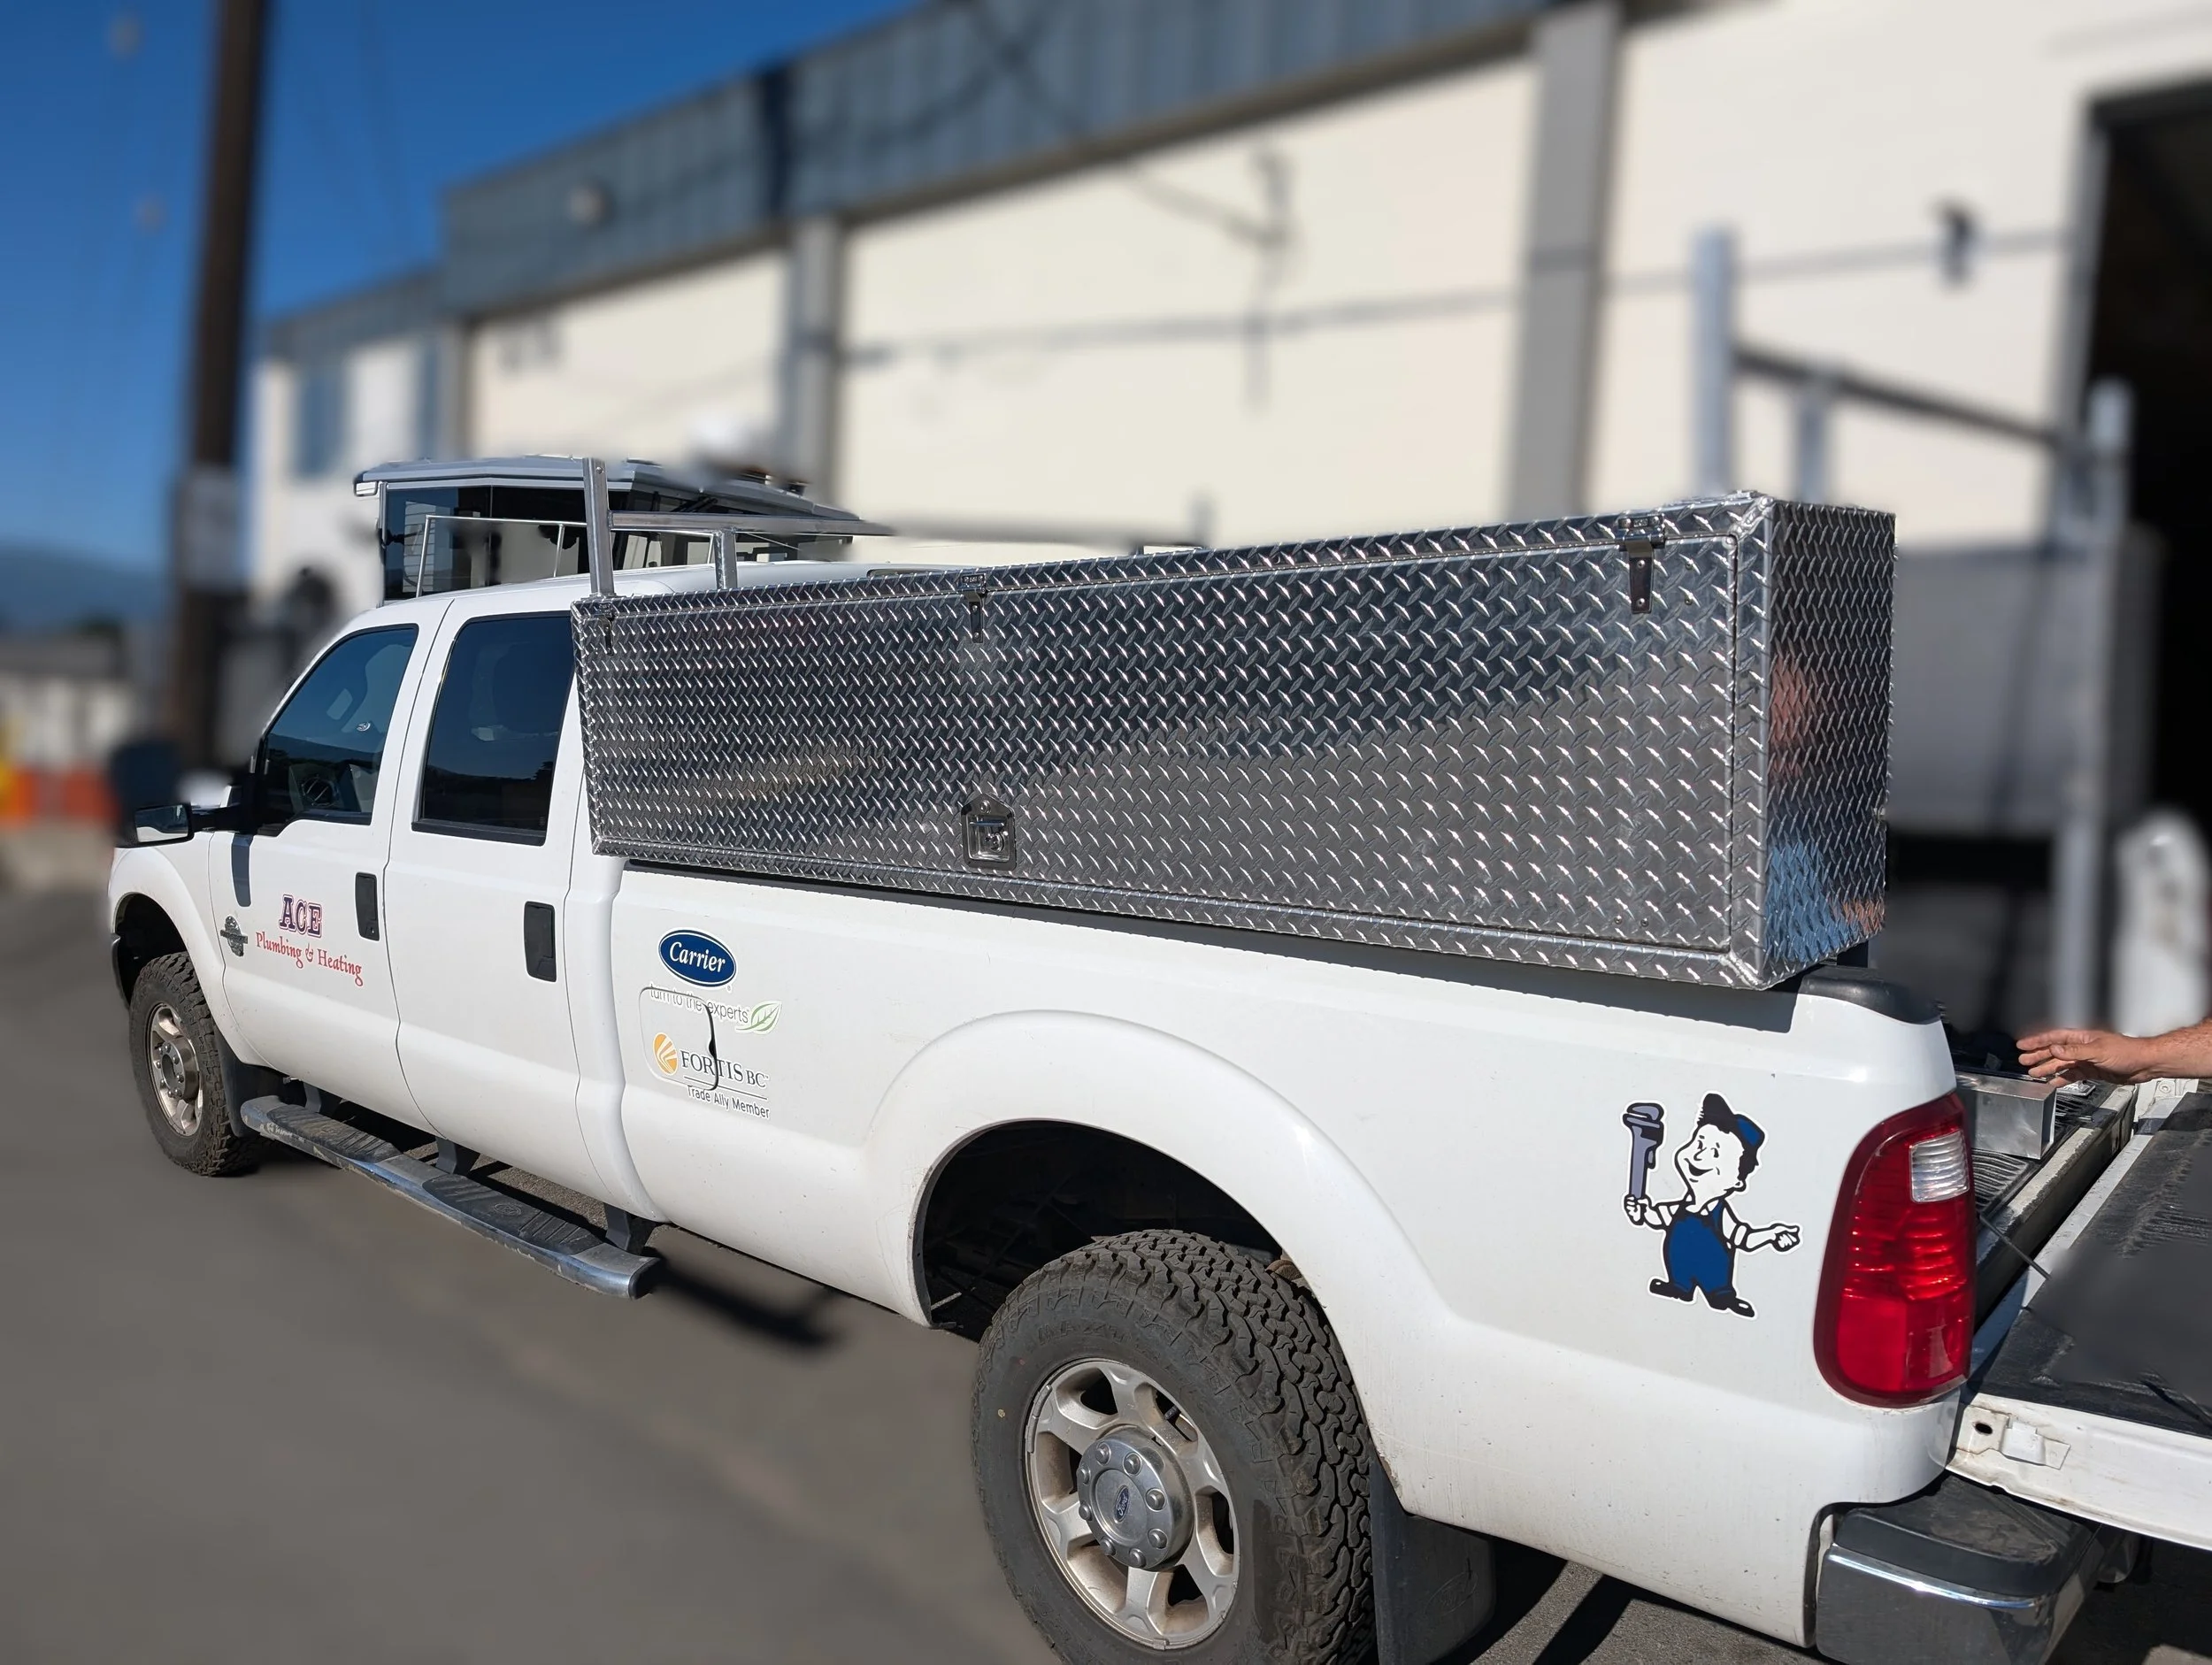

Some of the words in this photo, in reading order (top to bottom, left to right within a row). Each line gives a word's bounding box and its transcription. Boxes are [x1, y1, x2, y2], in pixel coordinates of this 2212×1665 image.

[279, 894, 322, 938] ACE
[256, 932, 303, 969] Plumbing
[304, 942, 313, 962] &
[317, 948, 364, 986] Heating
[669, 941, 726, 973] Carrier
[707, 1001, 749, 1024] experts
[680, 1050, 743, 1082] FORTIS
[687, 1085, 710, 1101] Trade
[714, 1093, 729, 1109] Ally
[732, 1097, 770, 1118] Member
